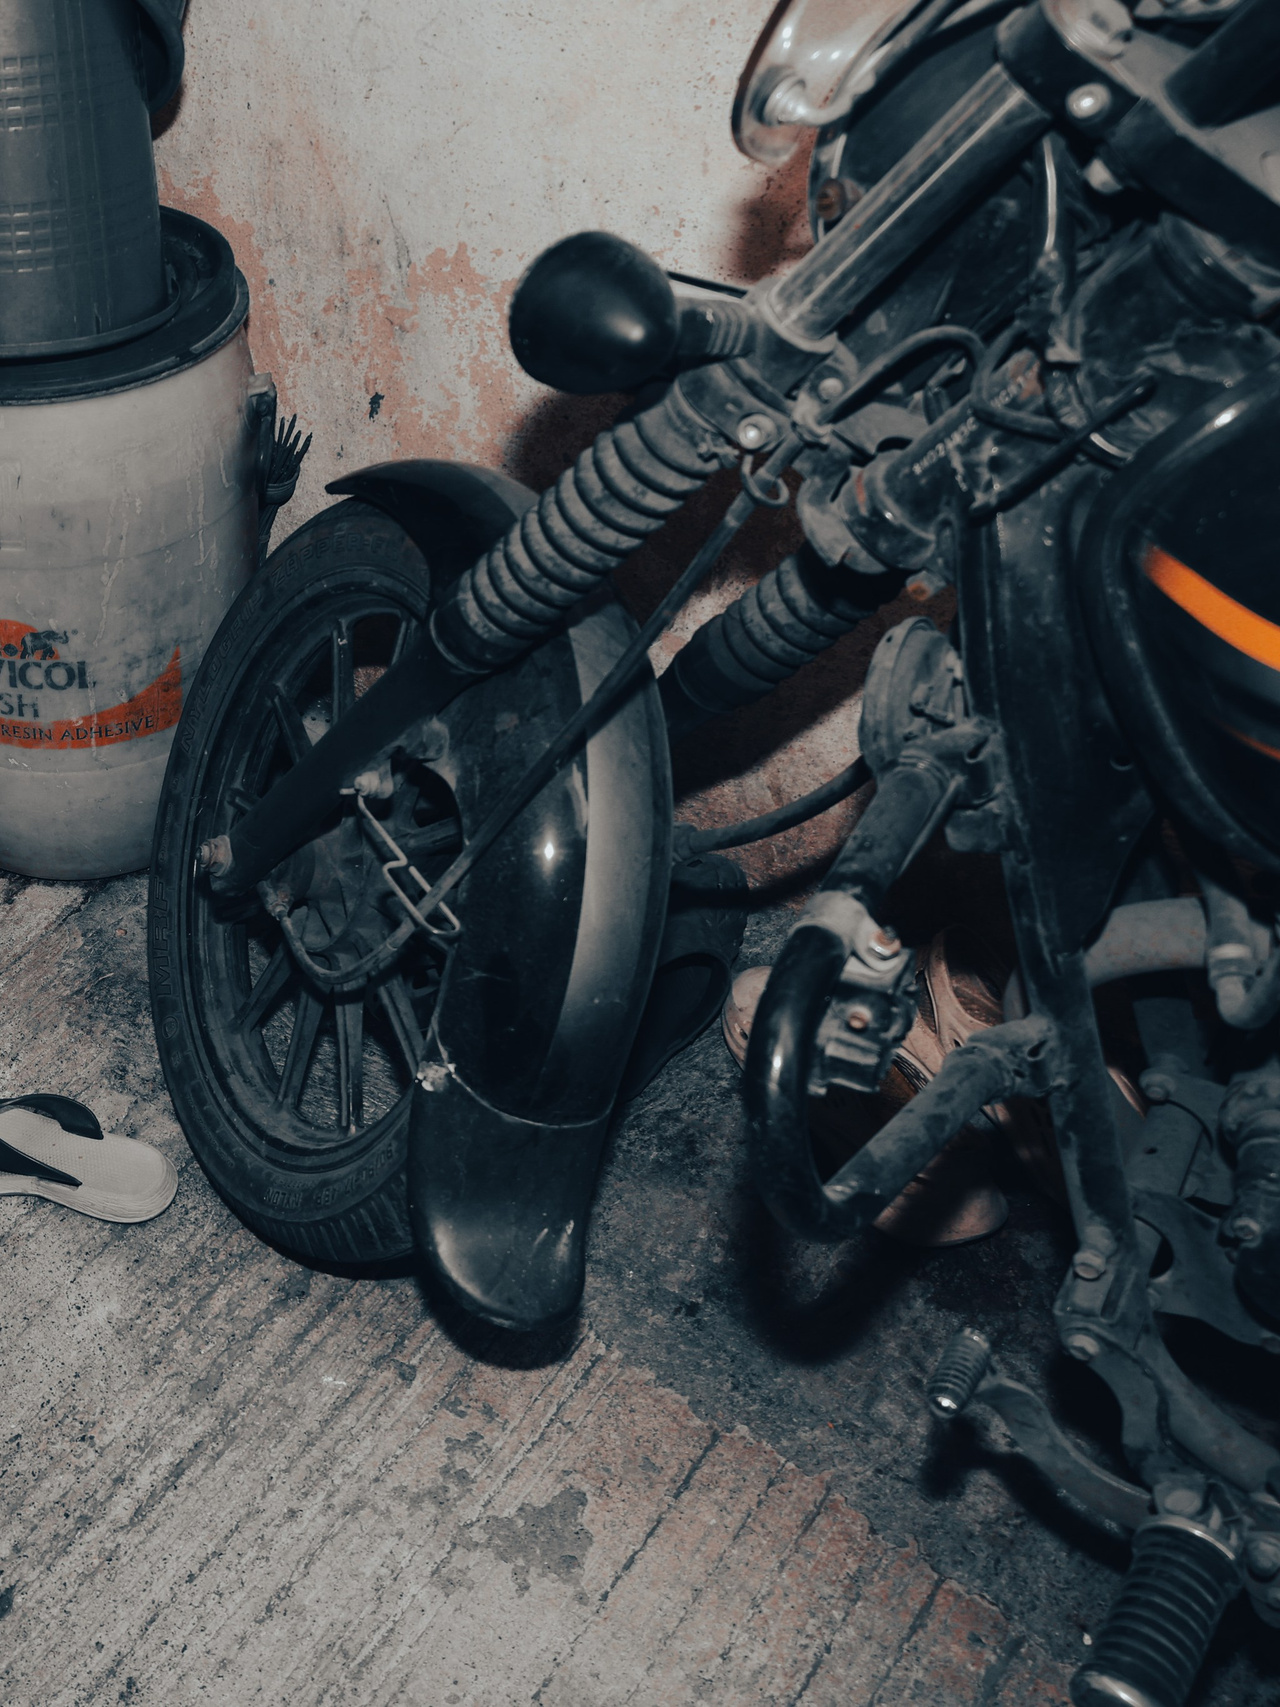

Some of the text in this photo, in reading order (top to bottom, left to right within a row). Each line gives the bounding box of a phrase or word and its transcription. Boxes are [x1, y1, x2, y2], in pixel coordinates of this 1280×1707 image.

[0, 692, 40, 719] SH
[1, 723, 53, 741] RESIN
[61, 714, 155, 742] ADHESIVE
[153, 876, 172, 997] MRF
[265, 1188, 303, 1210] NYLON
